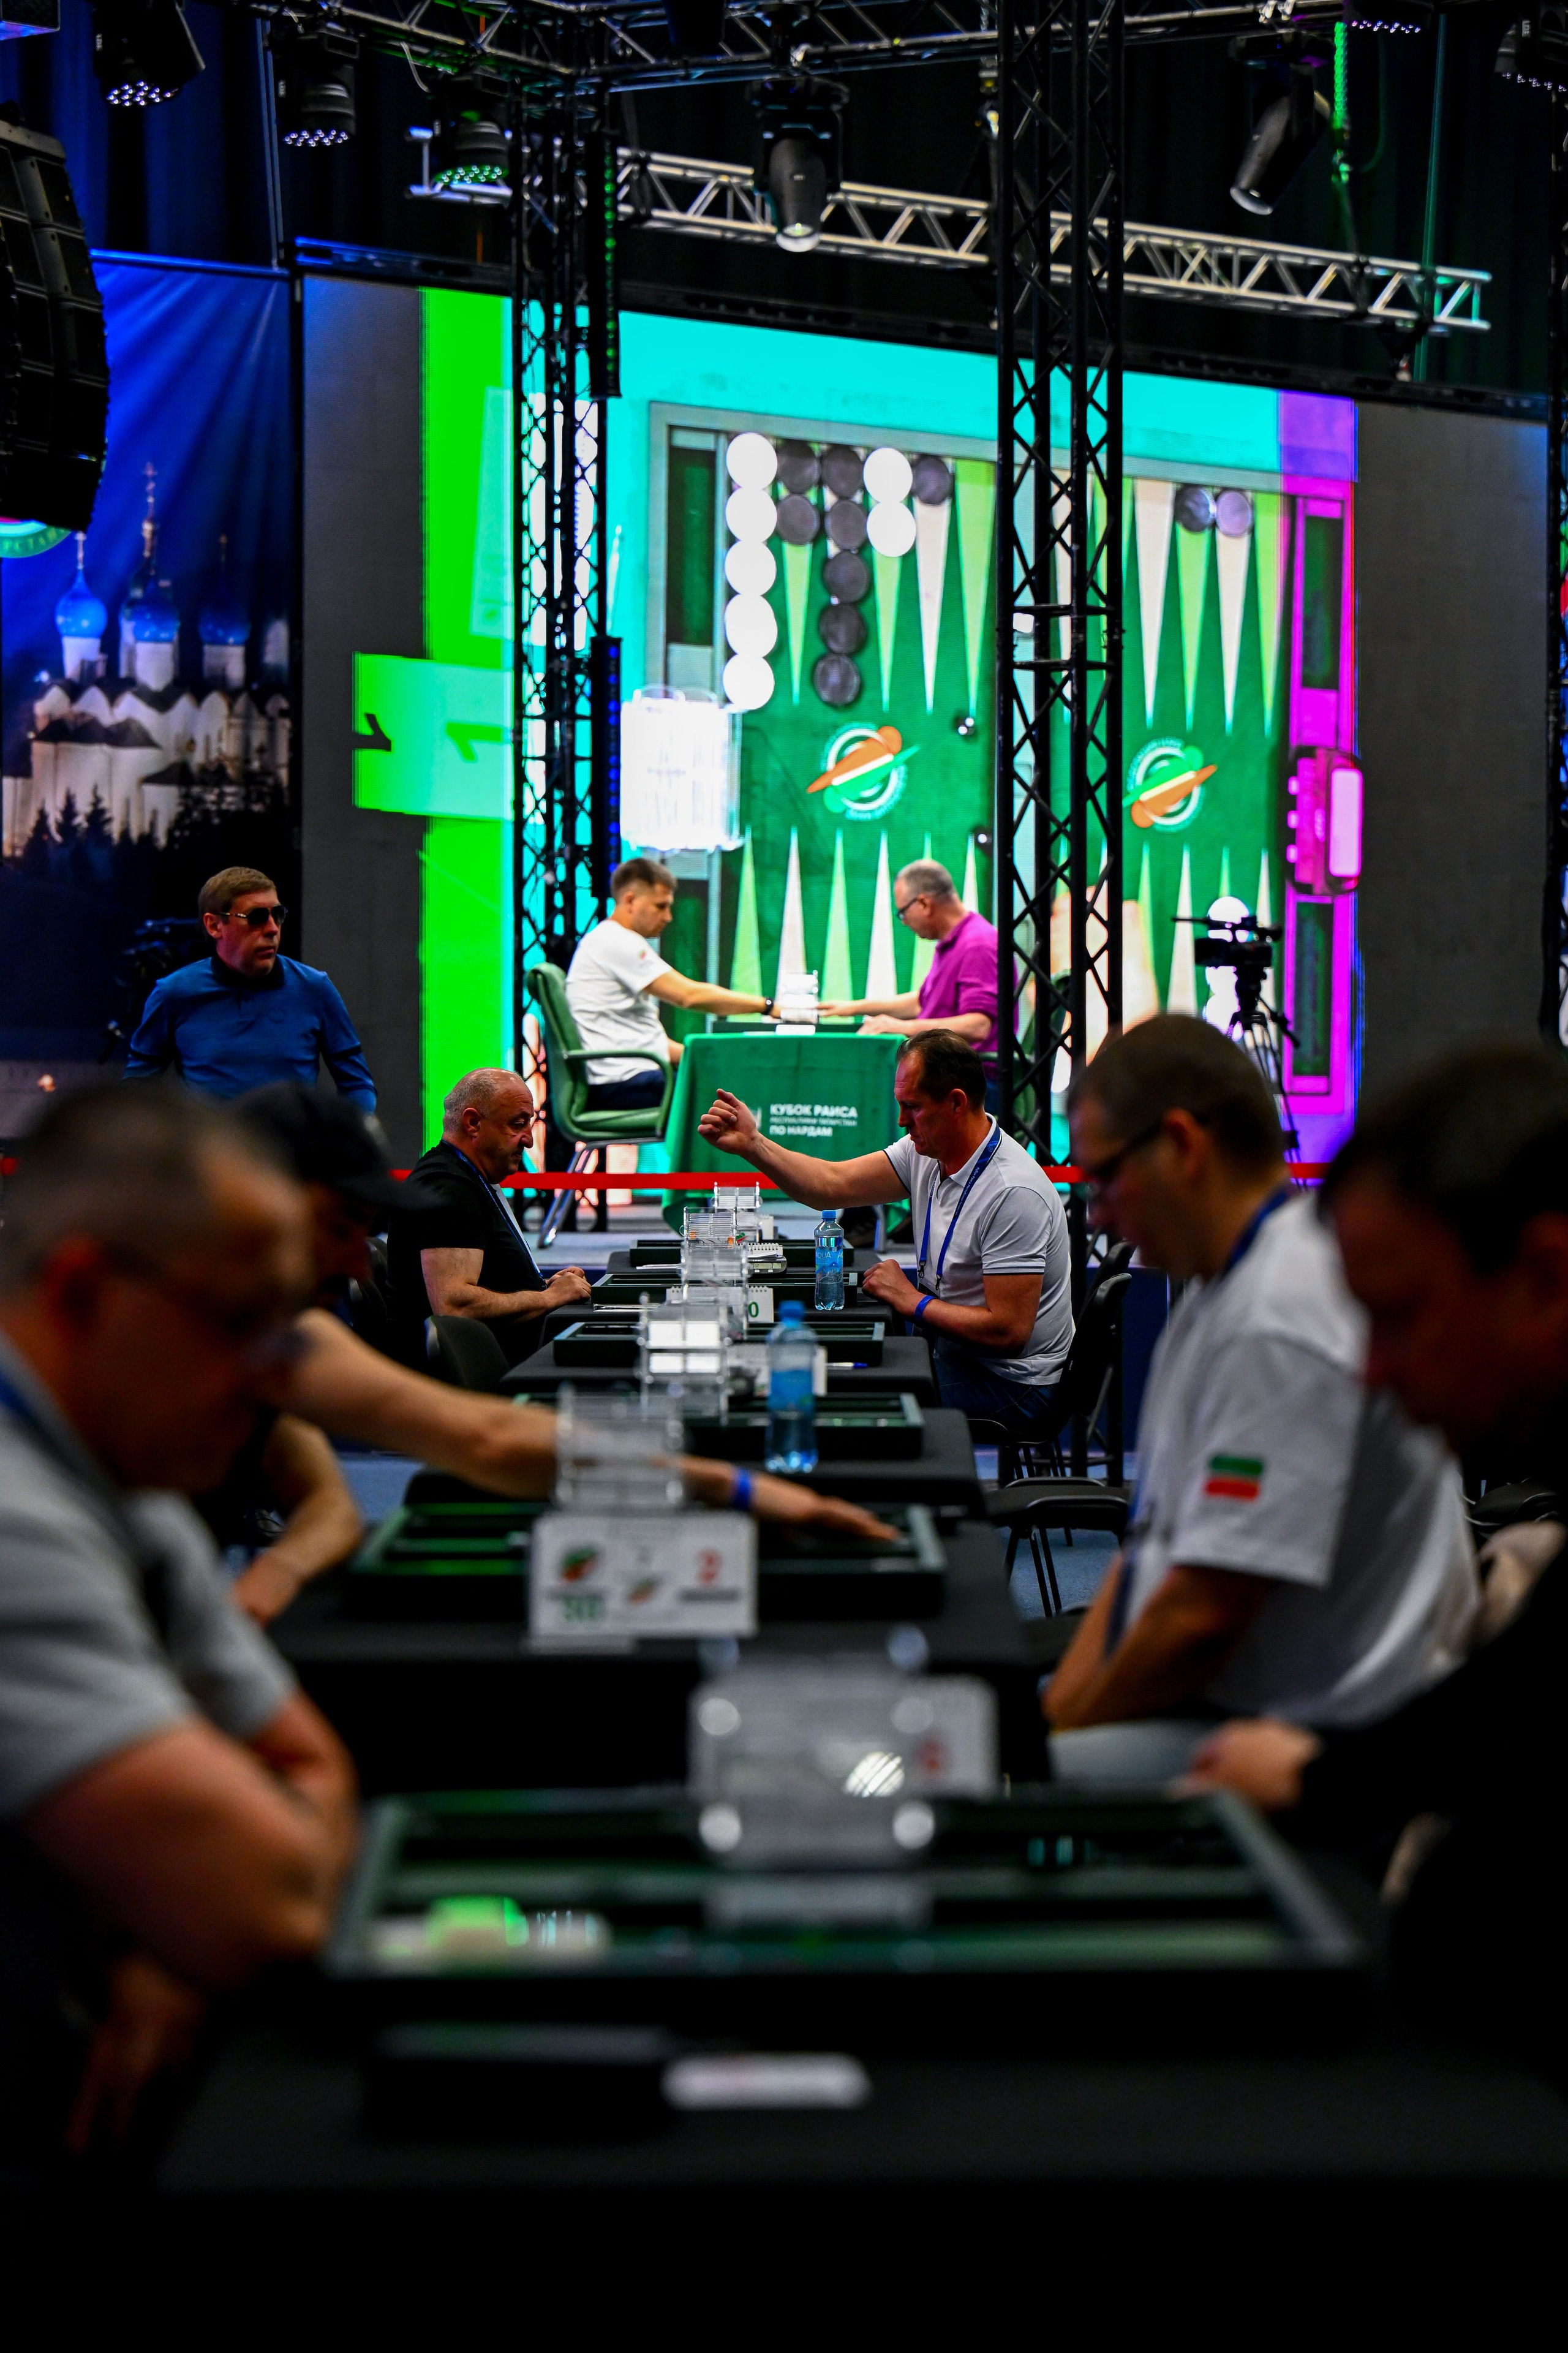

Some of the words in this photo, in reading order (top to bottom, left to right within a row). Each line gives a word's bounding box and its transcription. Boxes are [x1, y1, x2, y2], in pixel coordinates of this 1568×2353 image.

[770, 1103, 812, 1116] КУБОК
[813, 1105, 858, 1117] РАИСА
[769, 1125, 786, 1136] ПО
[787, 1125, 833, 1137] НАРДАМ
